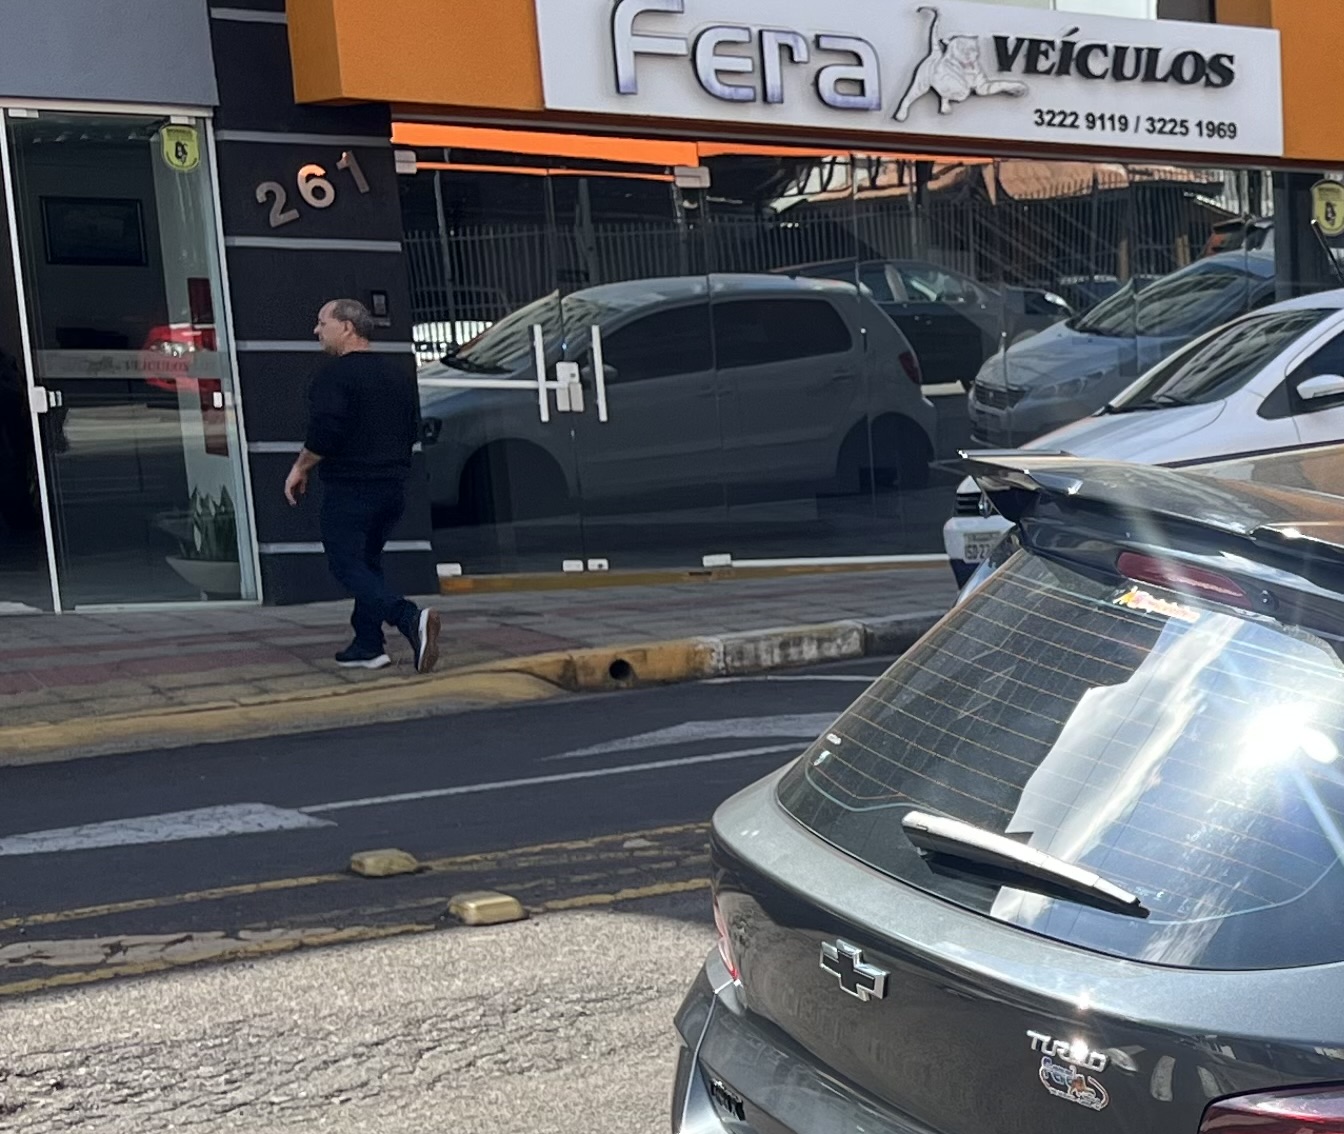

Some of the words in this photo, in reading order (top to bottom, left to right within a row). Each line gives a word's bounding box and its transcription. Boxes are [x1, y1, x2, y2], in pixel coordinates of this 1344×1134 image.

[611, 0, 883, 112] Fera
[991, 27, 1236, 89] VEÍCULOS
[1033, 108, 1080, 130] 3222
[1085, 111, 1129, 133] 9119
[1145, 116, 1191, 137] 3225
[1195, 119, 1238, 140] 1969
[255, 150, 371, 228] 261
[1026, 1029, 1107, 1072] TURO
